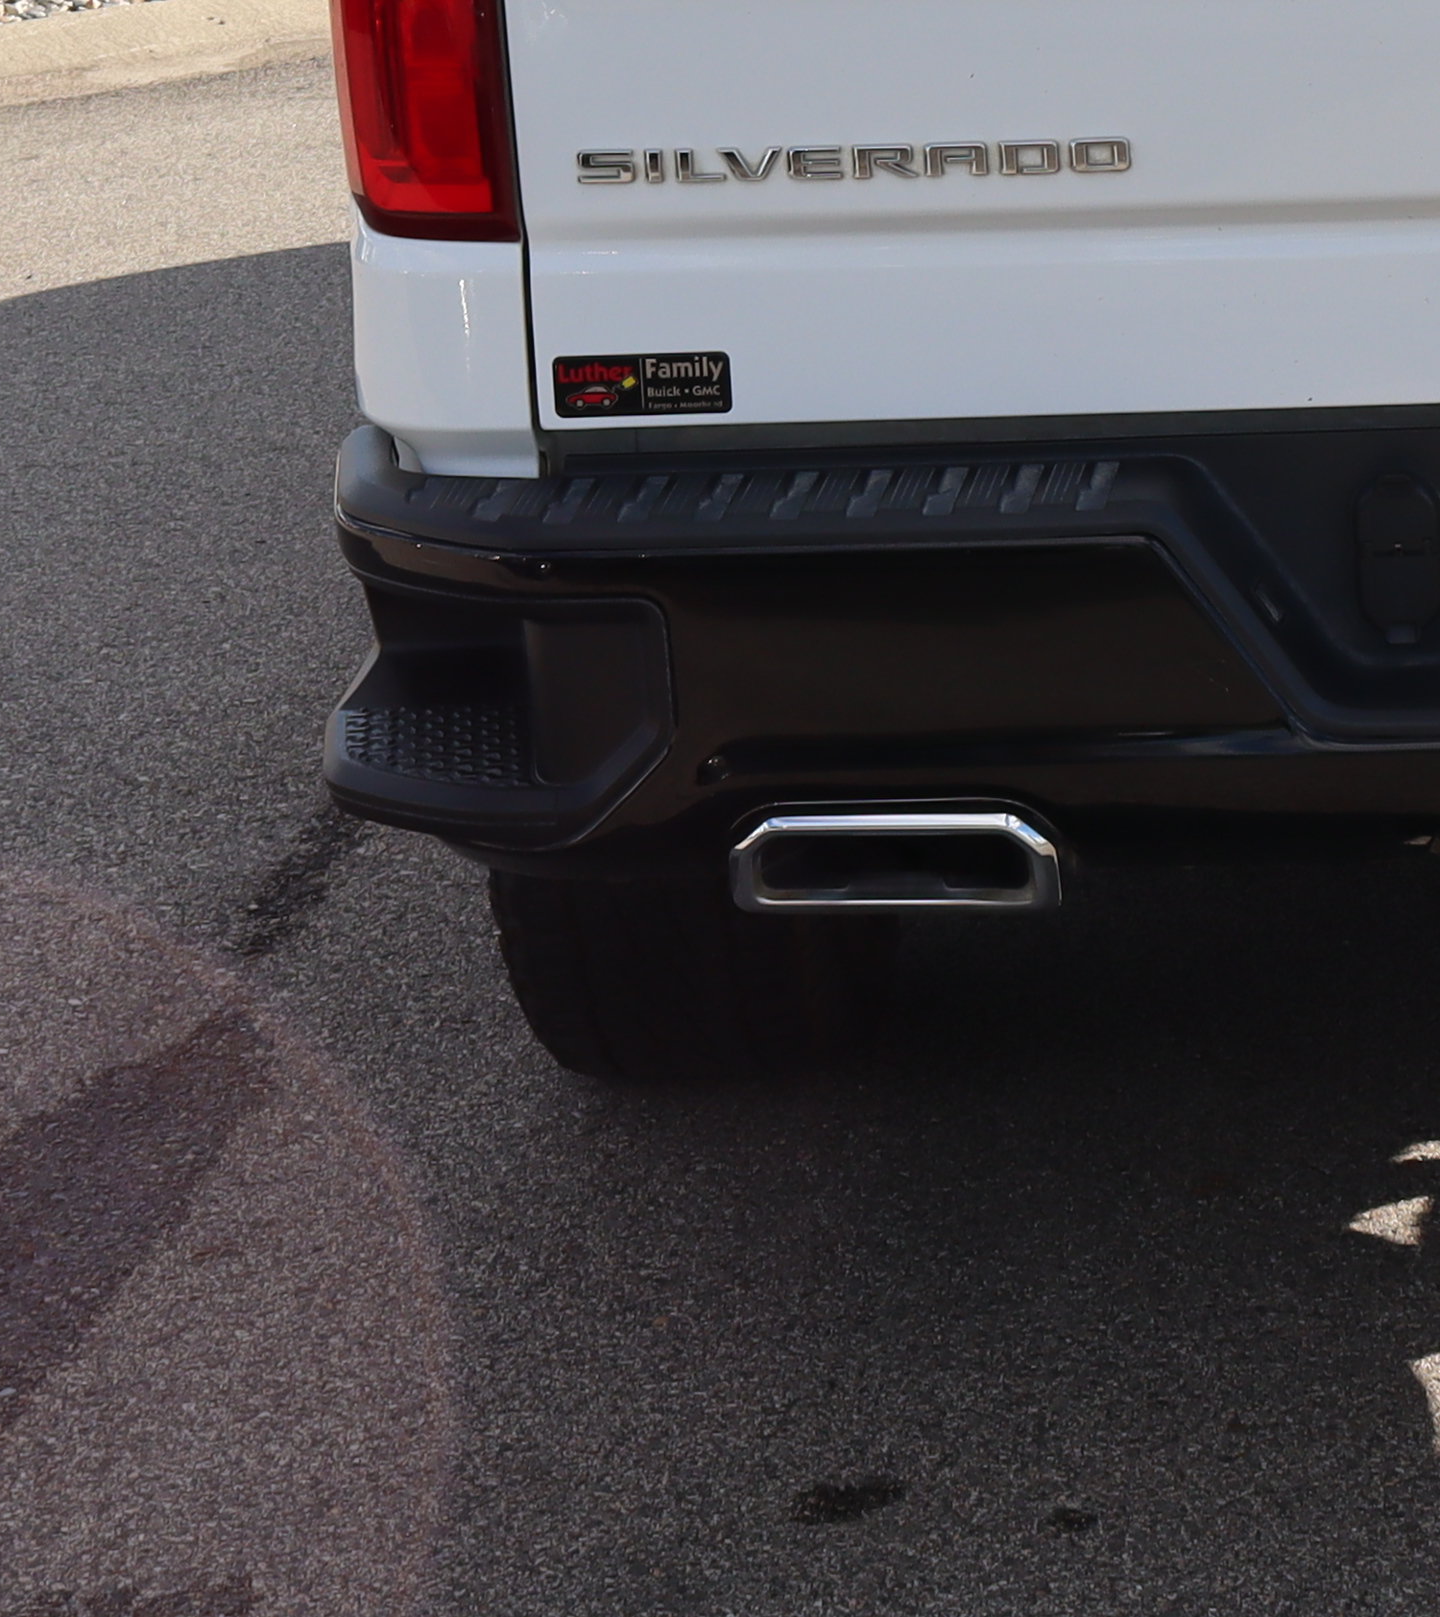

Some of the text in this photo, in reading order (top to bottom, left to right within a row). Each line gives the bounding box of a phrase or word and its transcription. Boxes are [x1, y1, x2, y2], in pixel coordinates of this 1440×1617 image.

[576, 136, 1133, 185] SILVERADO
[557, 356, 724, 383] Luther Family
[648, 385, 721, 397] Buick GMC
